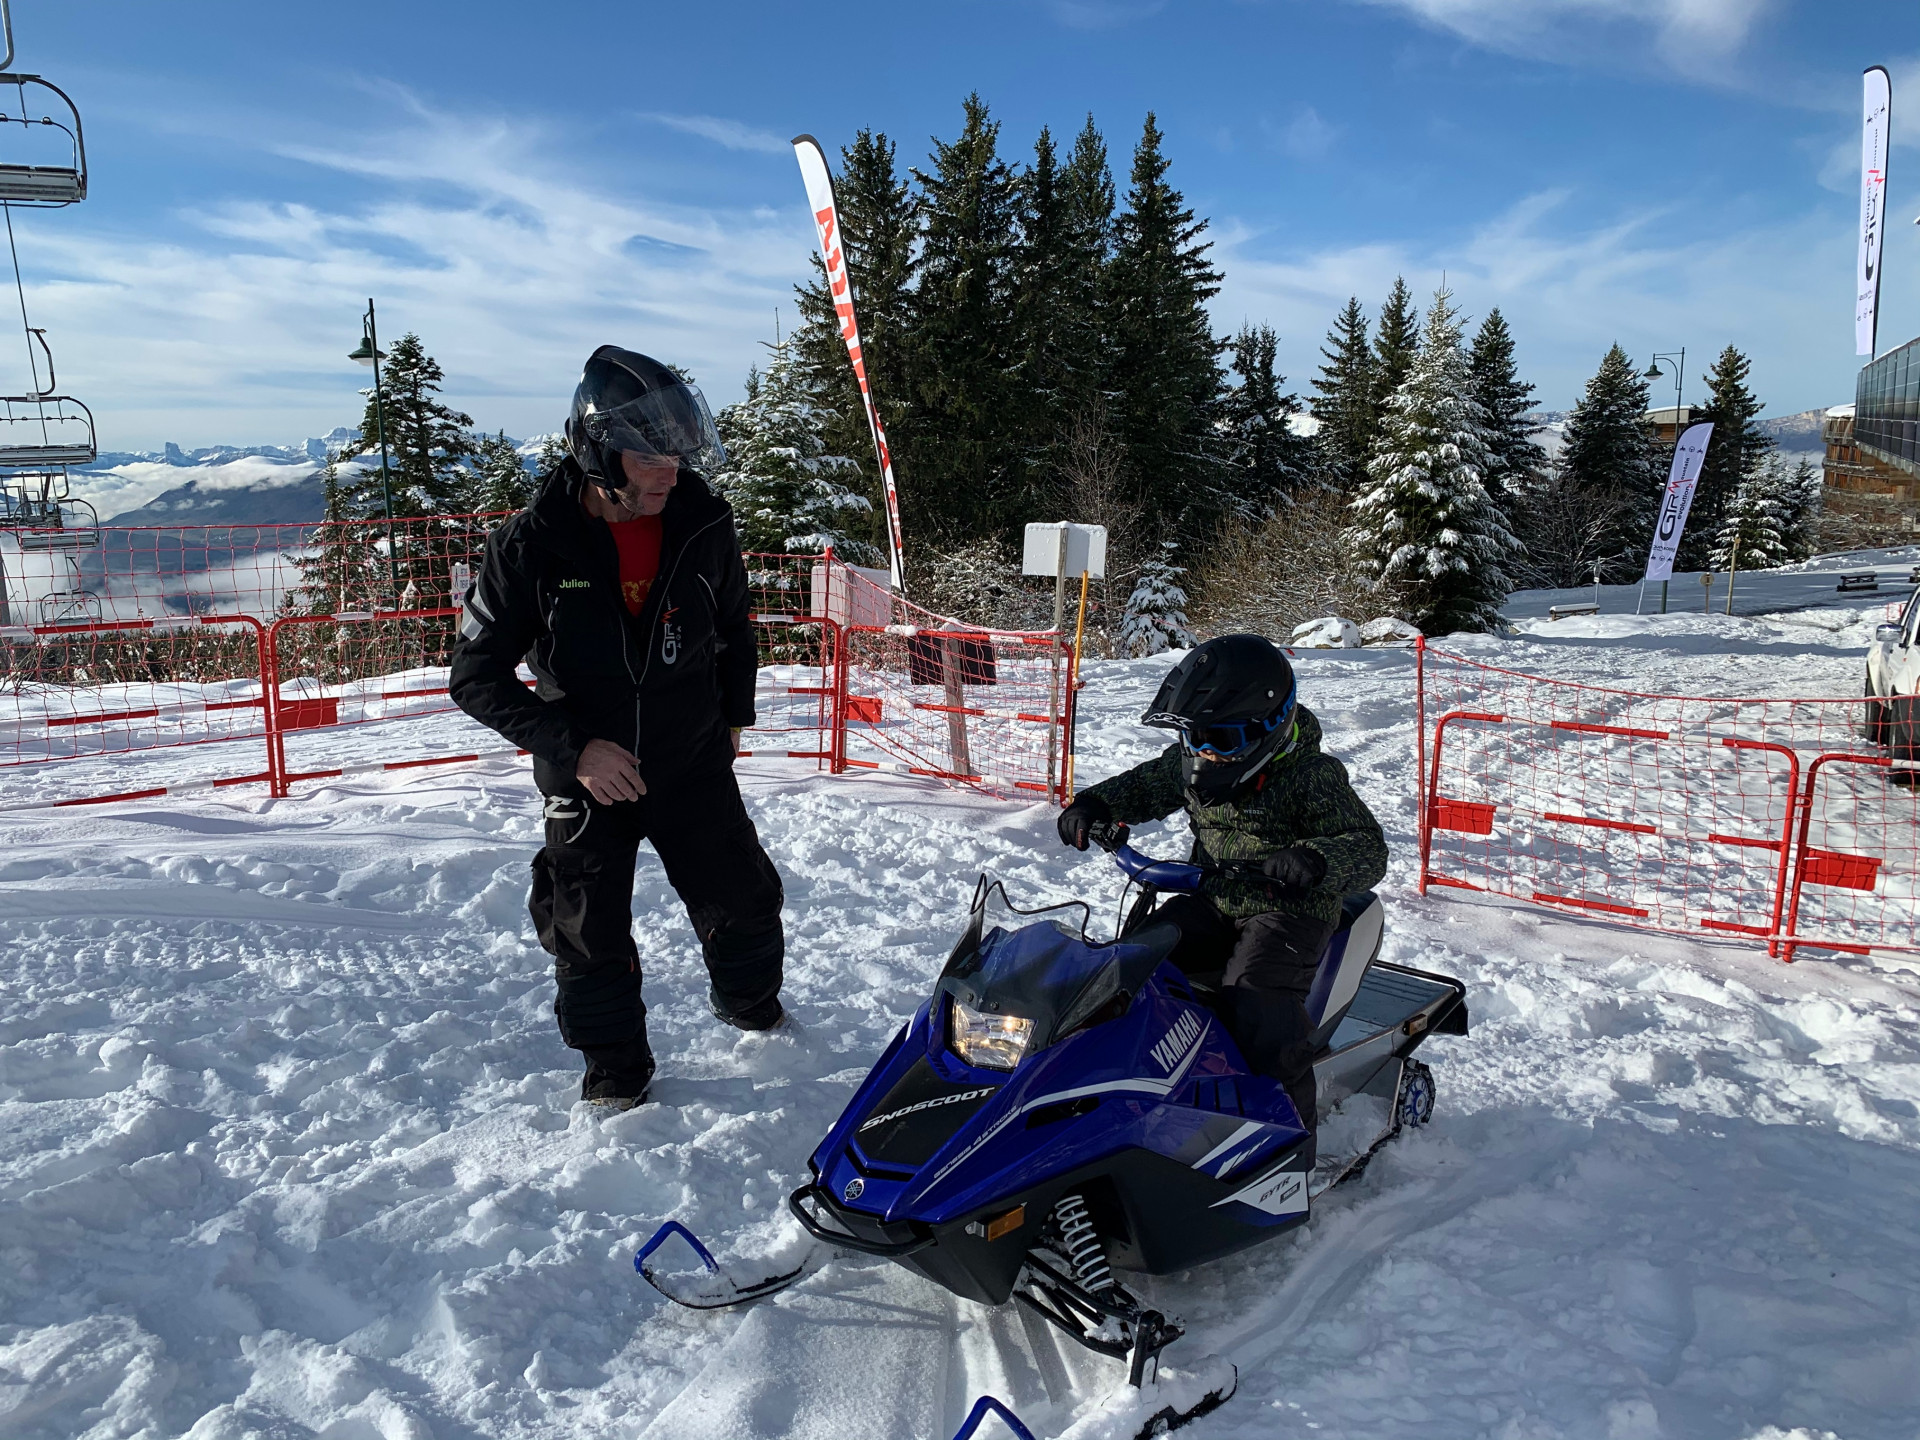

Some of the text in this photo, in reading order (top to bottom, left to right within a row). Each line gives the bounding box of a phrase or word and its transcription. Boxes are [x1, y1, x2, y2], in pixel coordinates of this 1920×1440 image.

[559, 579, 591, 589] Julien
[1150, 1008, 1202, 1075] YAMAHA
[859, 1086, 995, 1132] SNOSCOOT
[1259, 1175, 1291, 1204] GYTR
